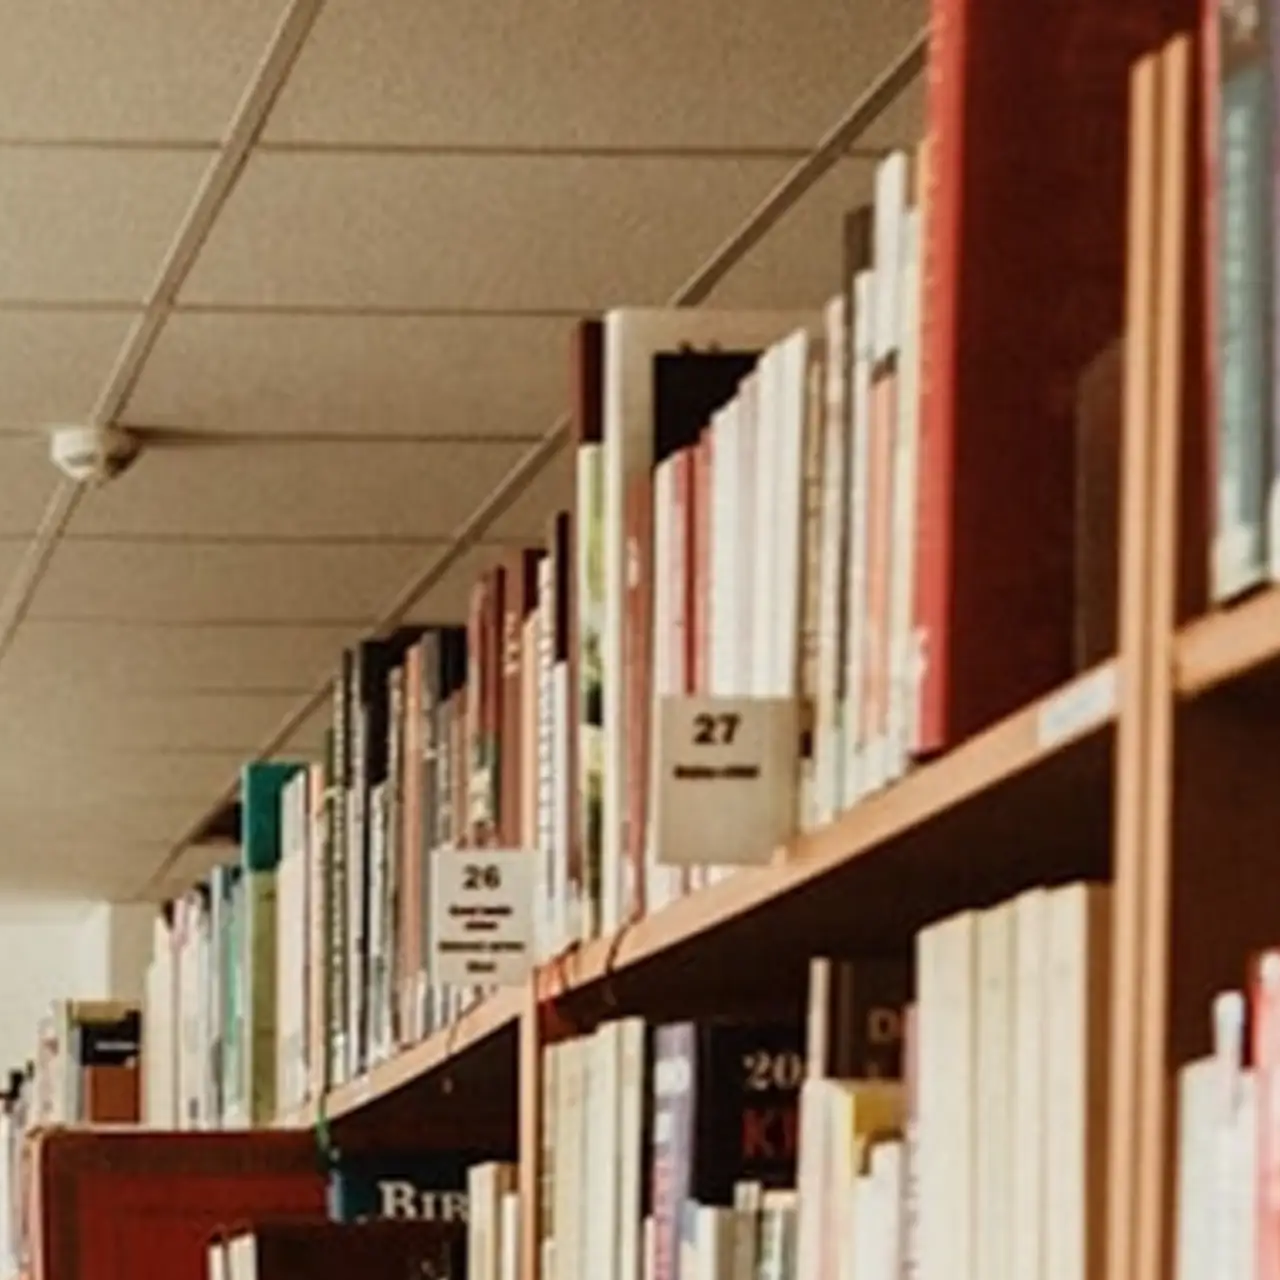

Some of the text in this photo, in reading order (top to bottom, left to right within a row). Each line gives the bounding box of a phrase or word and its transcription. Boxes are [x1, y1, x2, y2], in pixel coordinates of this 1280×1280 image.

[692, 711, 742, 745] 27
[462, 863, 502, 890] 26
[742, 1049, 807, 1092] 20
